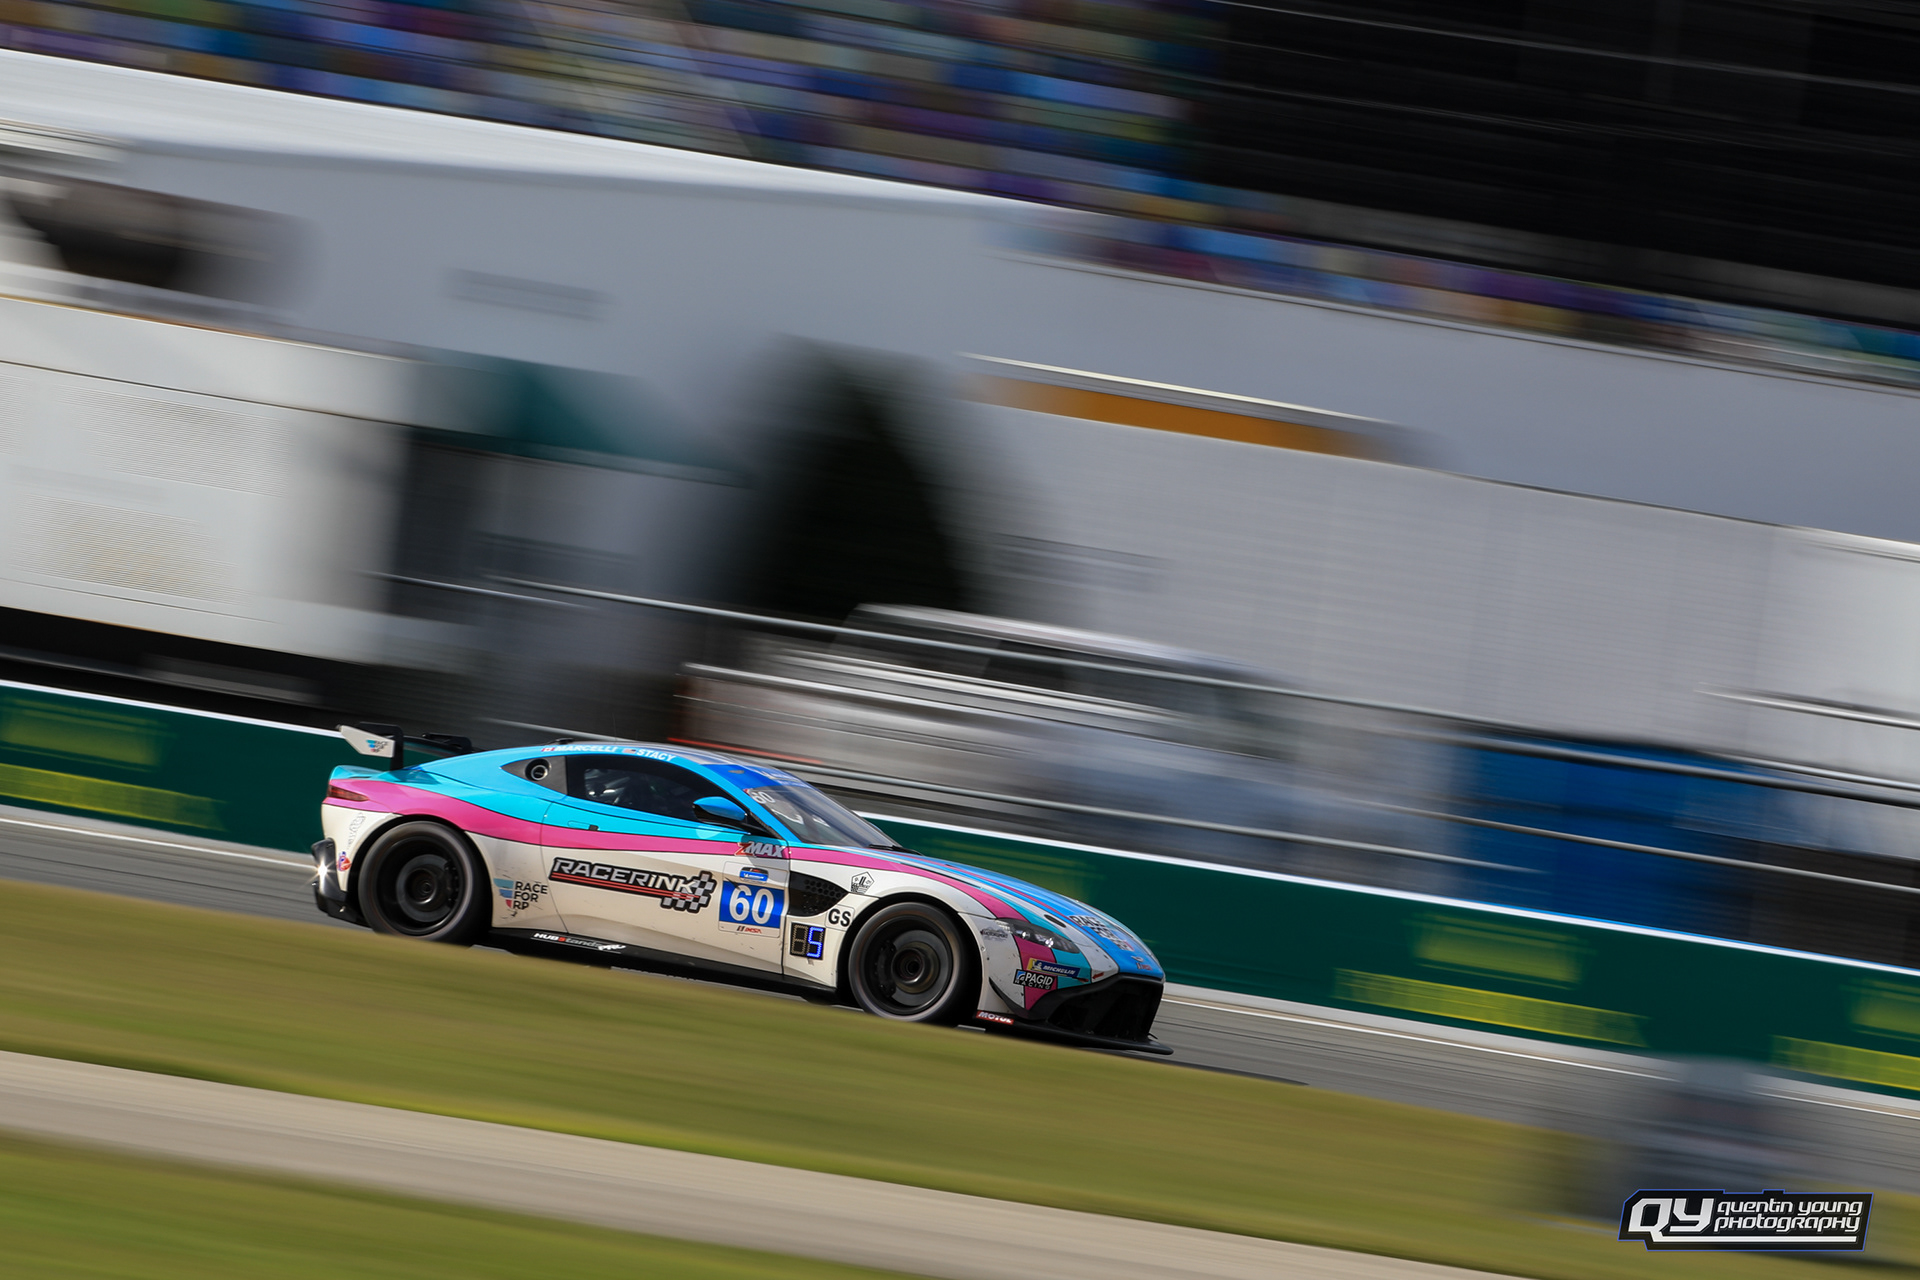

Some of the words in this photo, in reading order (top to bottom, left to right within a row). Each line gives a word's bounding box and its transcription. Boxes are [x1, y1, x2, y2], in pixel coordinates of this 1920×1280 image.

[556, 744, 618, 753] MARCELLI
[636, 749, 676, 762] STACY
[749, 791, 776, 804] 60
[735, 841, 786, 858] ZMAX
[515, 881, 548, 895] RACE
[514, 891, 539, 903] FOR
[513, 901, 530, 910] RP
[729, 885, 775, 925] 60
[828, 908, 851, 927] GS
[1042, 965, 1076, 975] MICHELIN
[1025, 972, 1053, 986] PAGID
